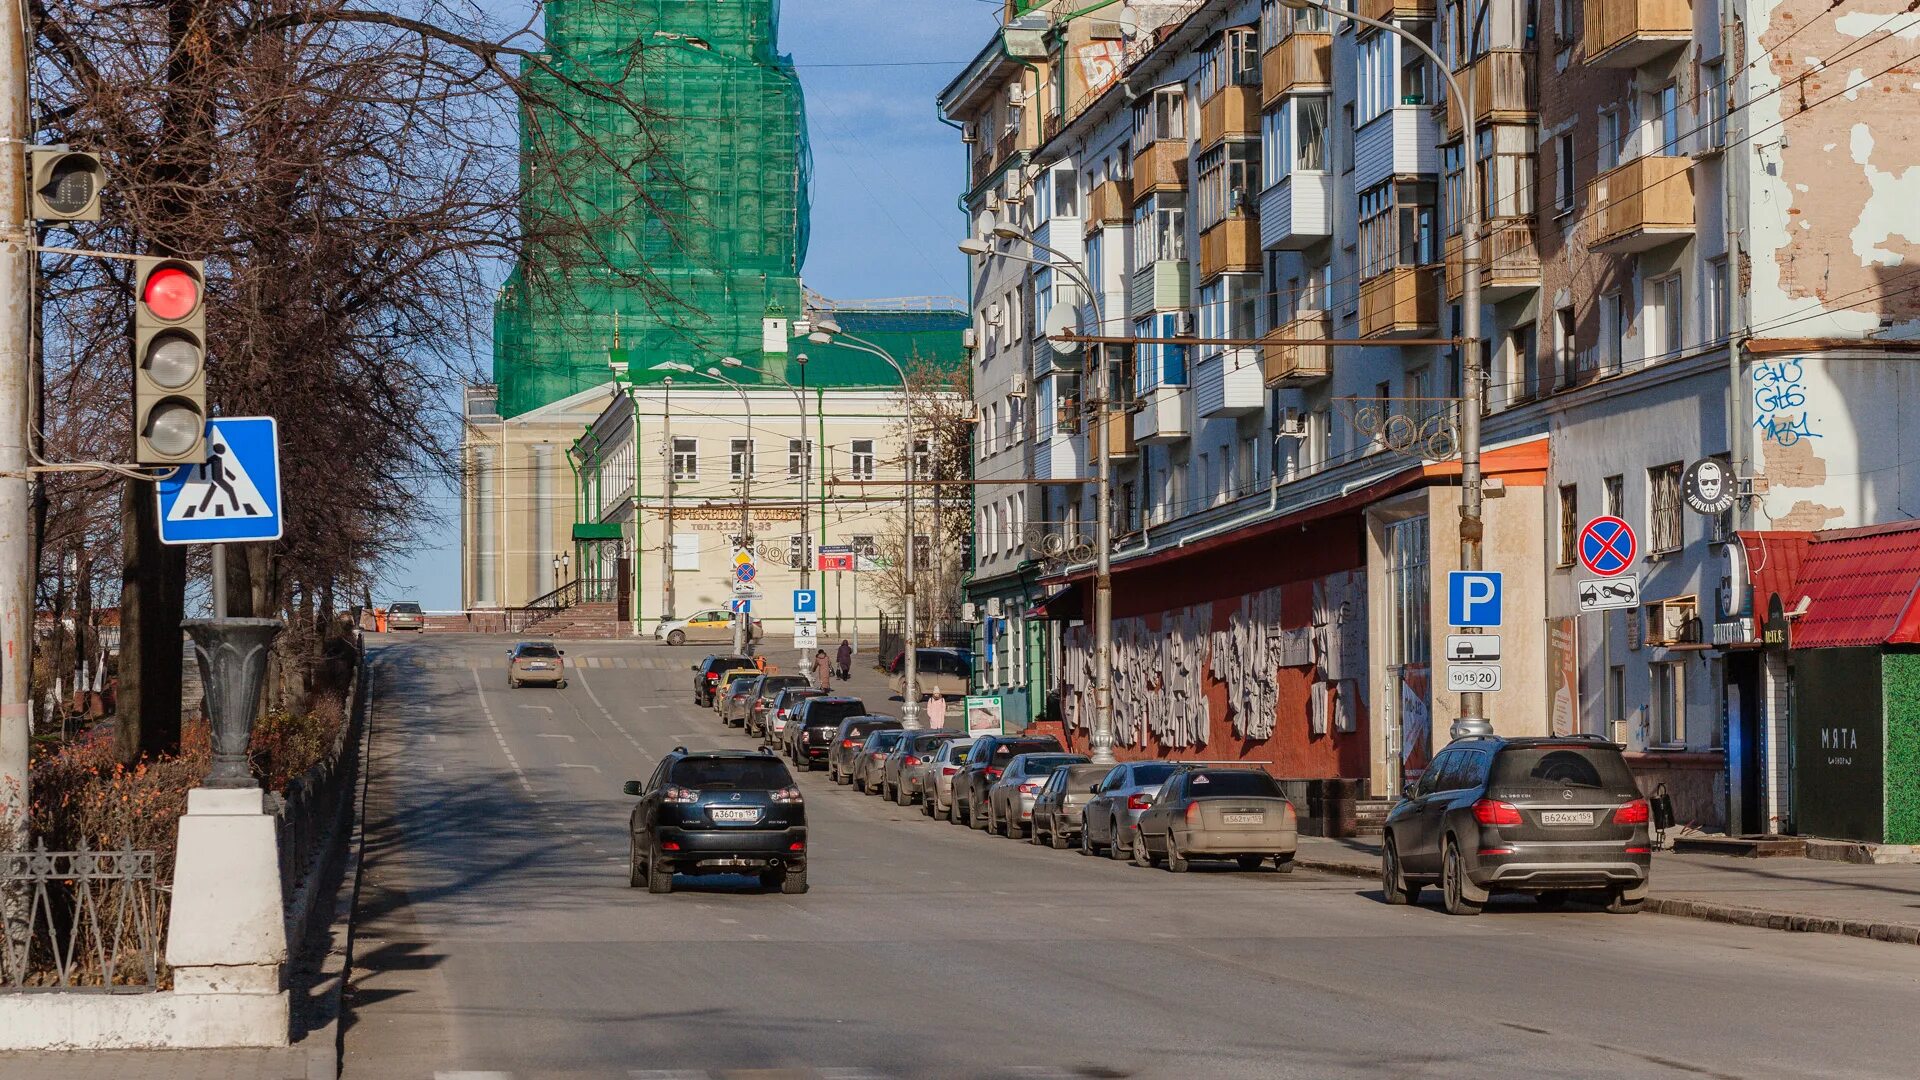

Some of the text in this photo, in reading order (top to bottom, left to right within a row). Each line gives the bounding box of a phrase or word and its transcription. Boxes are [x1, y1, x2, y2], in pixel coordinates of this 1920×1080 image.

[1687, 494, 1716, 513] HOOKAH
[797, 592, 812, 610] P
[1463, 575, 1496, 622] P
[1453, 673, 1492, 683] 10 15 20
[1821, 727, 1857, 749] МЯТА
